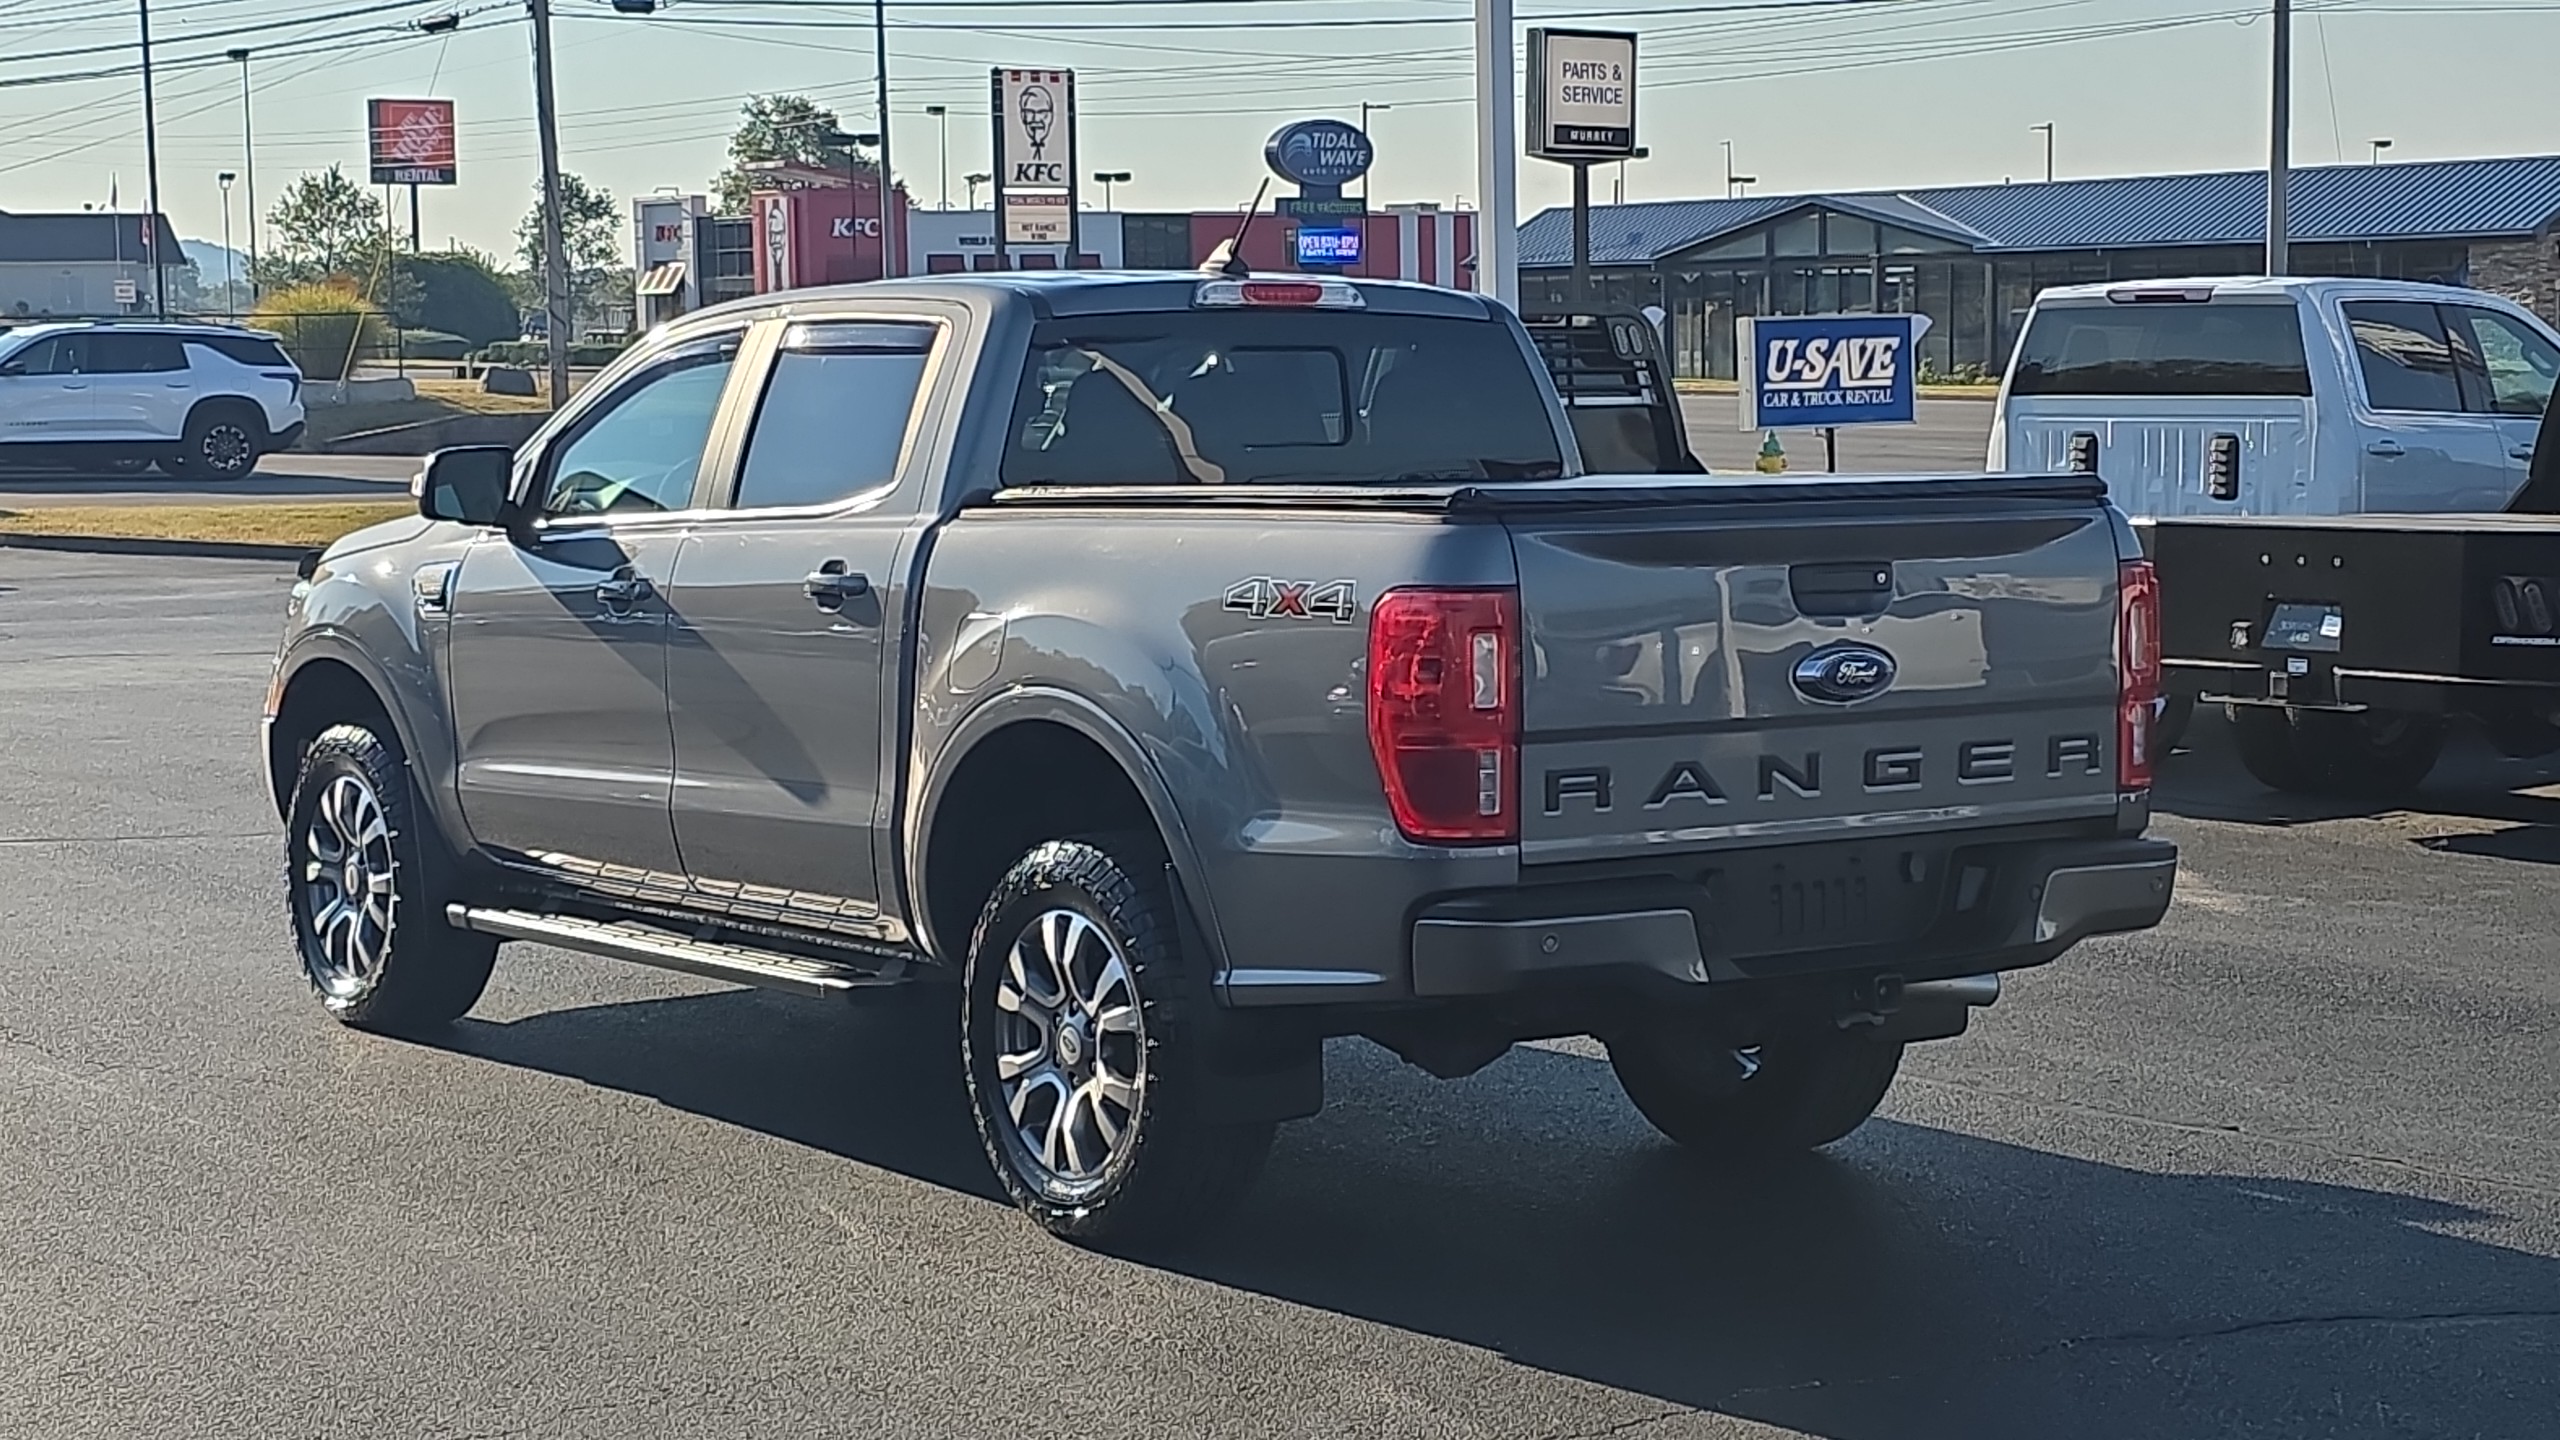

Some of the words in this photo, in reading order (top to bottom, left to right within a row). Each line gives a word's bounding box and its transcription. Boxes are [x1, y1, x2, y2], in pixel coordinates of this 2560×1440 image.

[1562, 61, 1607, 80] PARTS
[1612, 63, 1623, 81] &
[1562, 85, 1623, 104] SERVICE
[1312, 132, 1357, 148] TIDAL
[1319, 150, 1367, 166] WAVE
[393, 167, 443, 182] RENTAL
[1014, 163, 1062, 182] KFC
[832, 218, 880, 237] KFC
[1766, 336, 1901, 388] U-SAVE
[1763, 392, 1789, 407] CAR
[1790, 392, 1801, 406] &
[1802, 390, 1844, 406] TRUCK
[1845, 388, 1894, 405] RENTAL
[1836, 661, 1878, 684] Ford
[1543, 732, 2103, 817] RANGER
